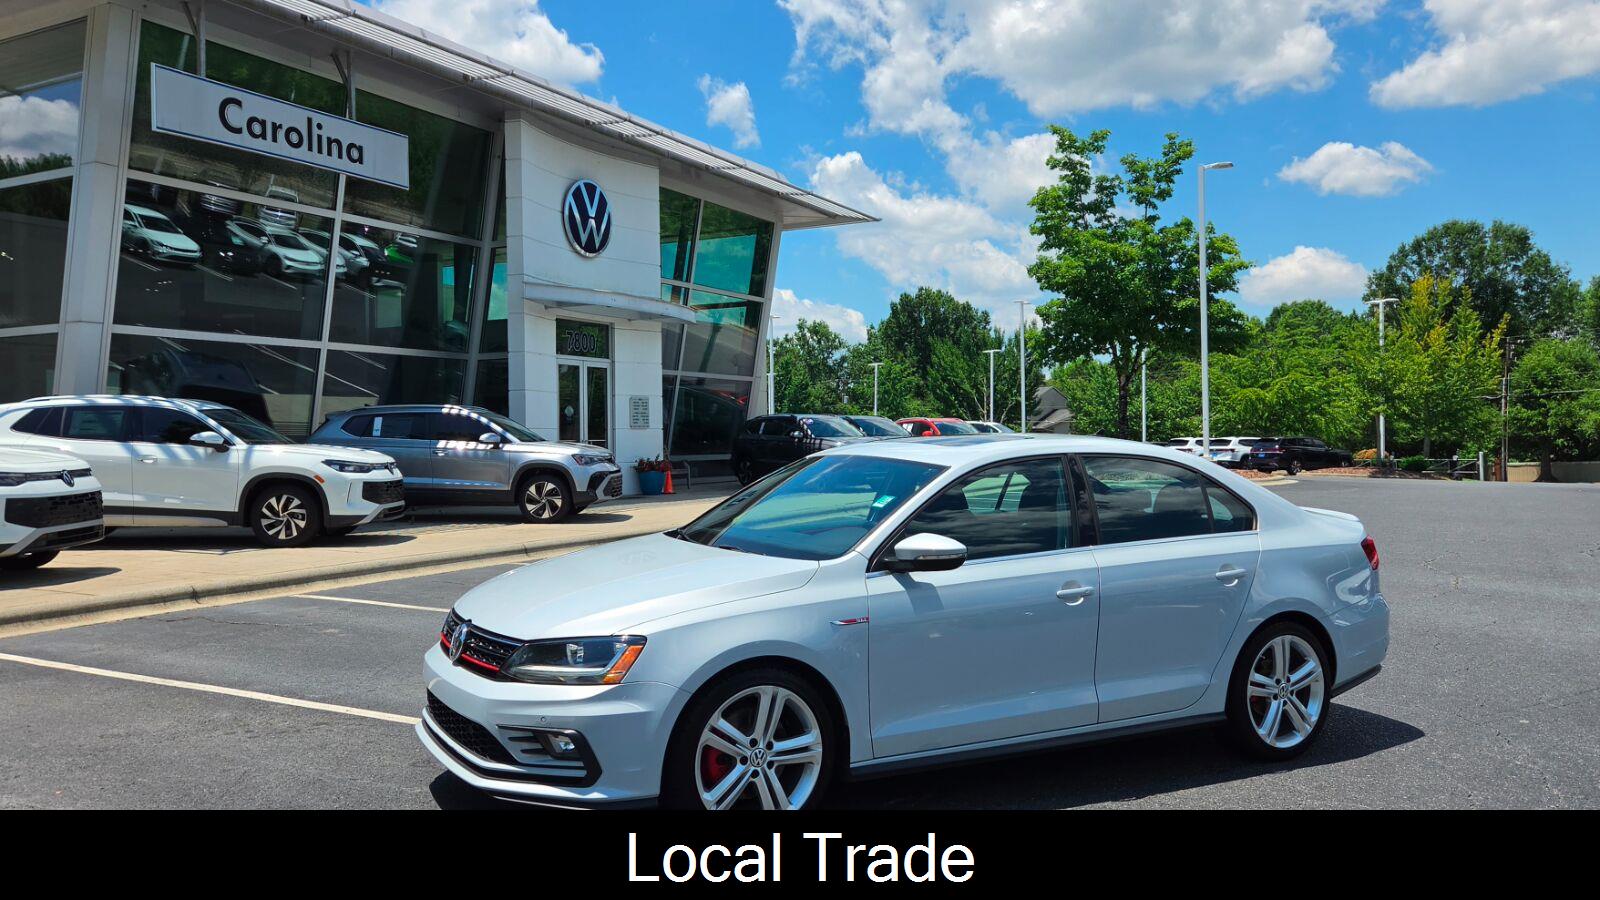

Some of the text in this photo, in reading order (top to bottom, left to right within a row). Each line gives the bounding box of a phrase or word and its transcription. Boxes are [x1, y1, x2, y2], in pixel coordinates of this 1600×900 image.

[218, 97, 364, 165] Carolina
[565, 180, 612, 252] VW
[565, 330, 597, 352] 7800
[750, 748, 767, 767] VW
